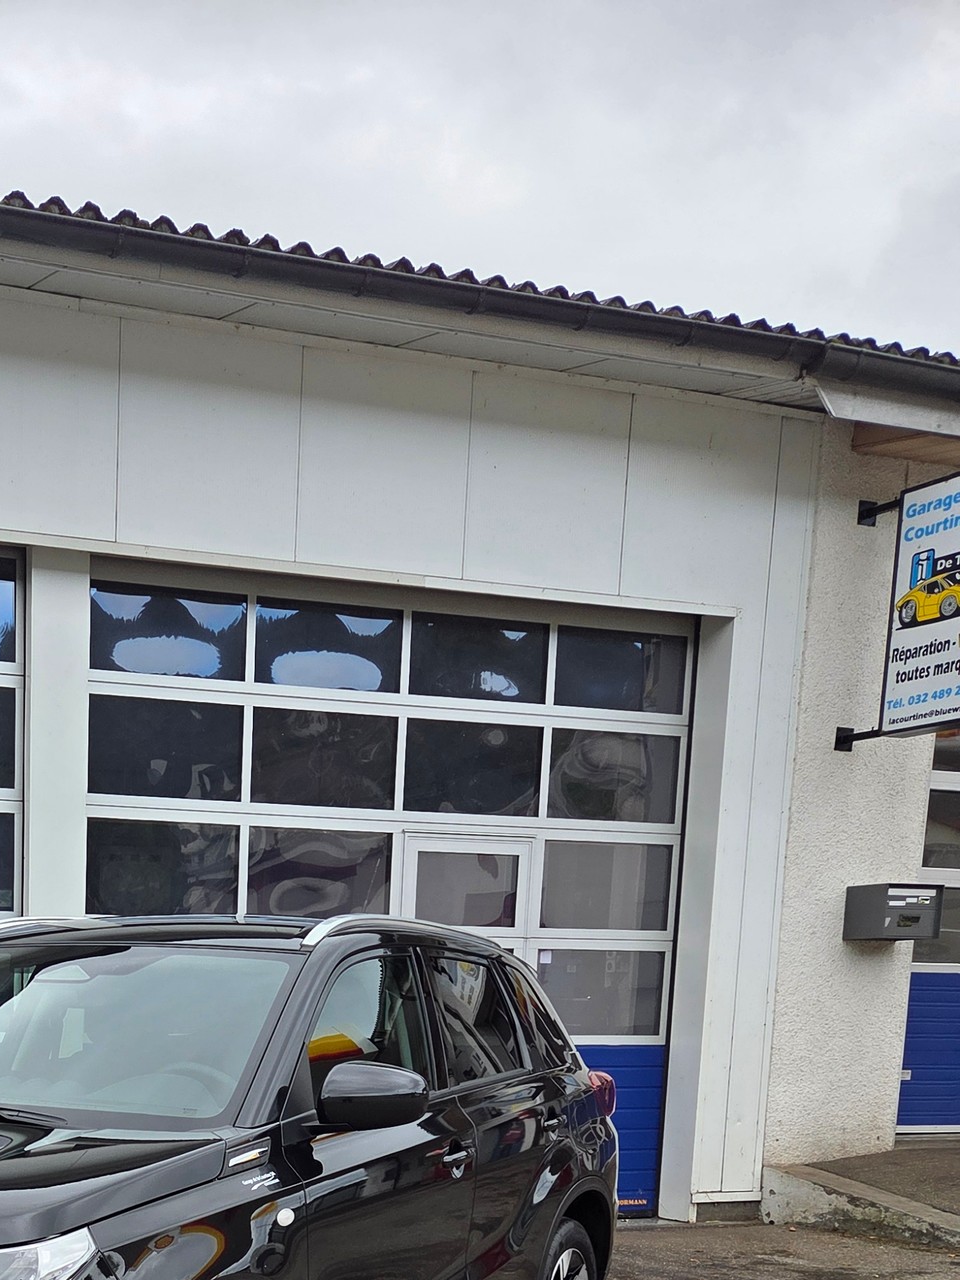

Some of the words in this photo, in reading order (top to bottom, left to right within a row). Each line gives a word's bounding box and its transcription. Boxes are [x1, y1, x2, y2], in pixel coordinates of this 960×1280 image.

[906, 492, 960, 518] Garage
[937, 560, 952, 571] De
[892, 638, 950, 665] Réparation
[896, 666, 931, 684] toutes
[887, 698, 905, 710] Tél.
[908, 693, 929, 706] 032
[931, 687, 952, 700] 489
